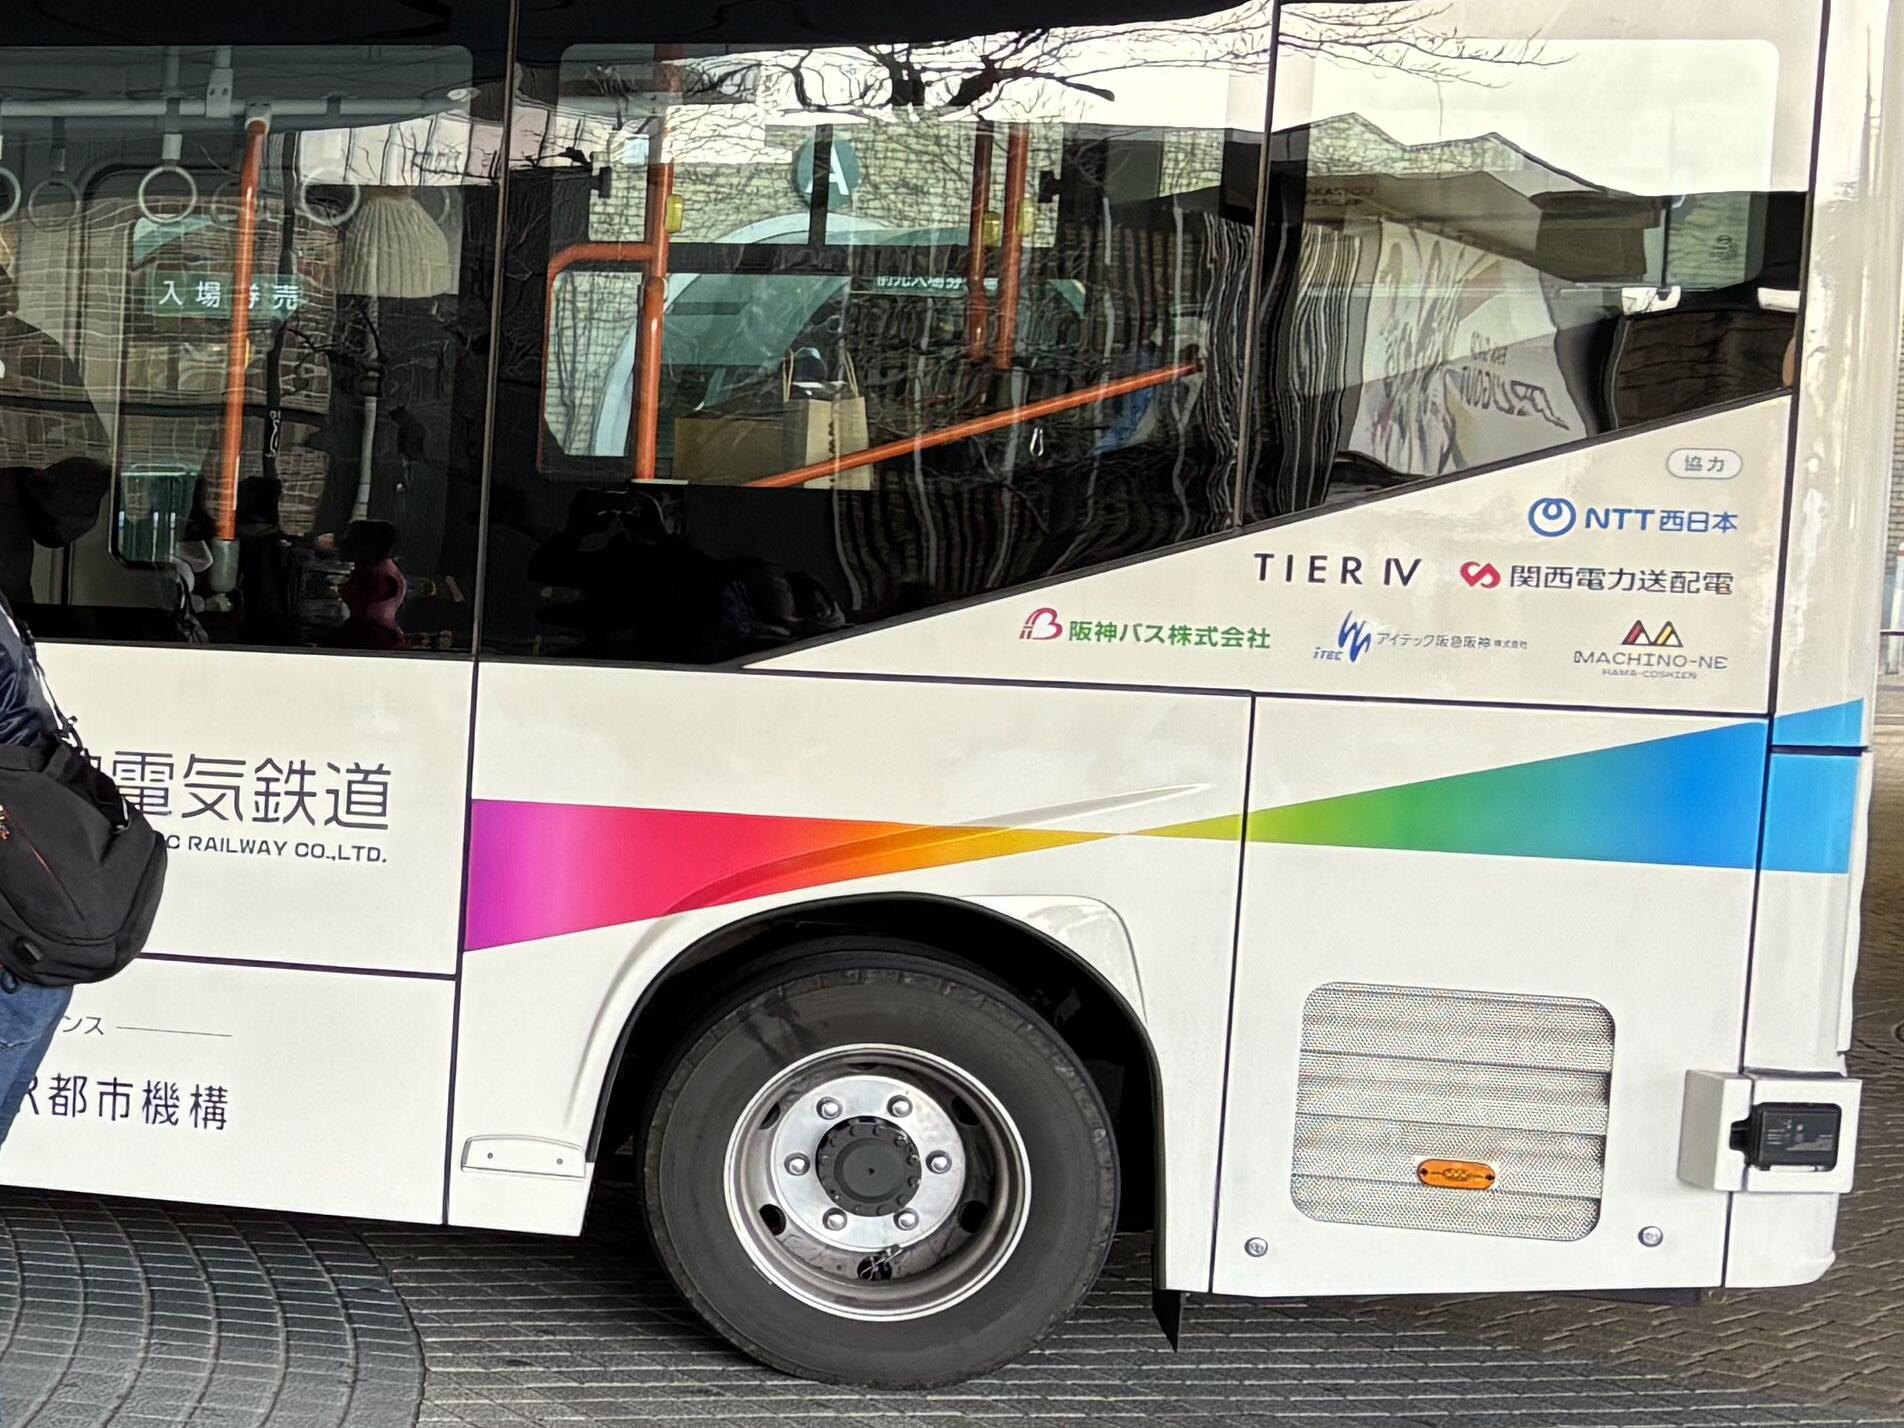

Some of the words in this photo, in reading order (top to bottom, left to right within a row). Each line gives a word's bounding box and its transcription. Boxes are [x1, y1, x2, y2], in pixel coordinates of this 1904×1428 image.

[1683, 455, 1726, 474] 協力
[1584, 507, 1739, 533] NTT西日本
[1254, 553, 1363, 586] TIER
[1384, 558, 1422, 587] IV
[1510, 564, 1734, 596] 関西電力送配電
[1068, 620, 1271, 650] 阪神バス株式会社
[1377, 632, 1491, 649] アイテック阪急阪神
[1574, 650, 1728, 670] MACHINO-NE
[91, 750, 392, 831] 電気鉄道
[189, 834, 288, 858] RAILWAY
